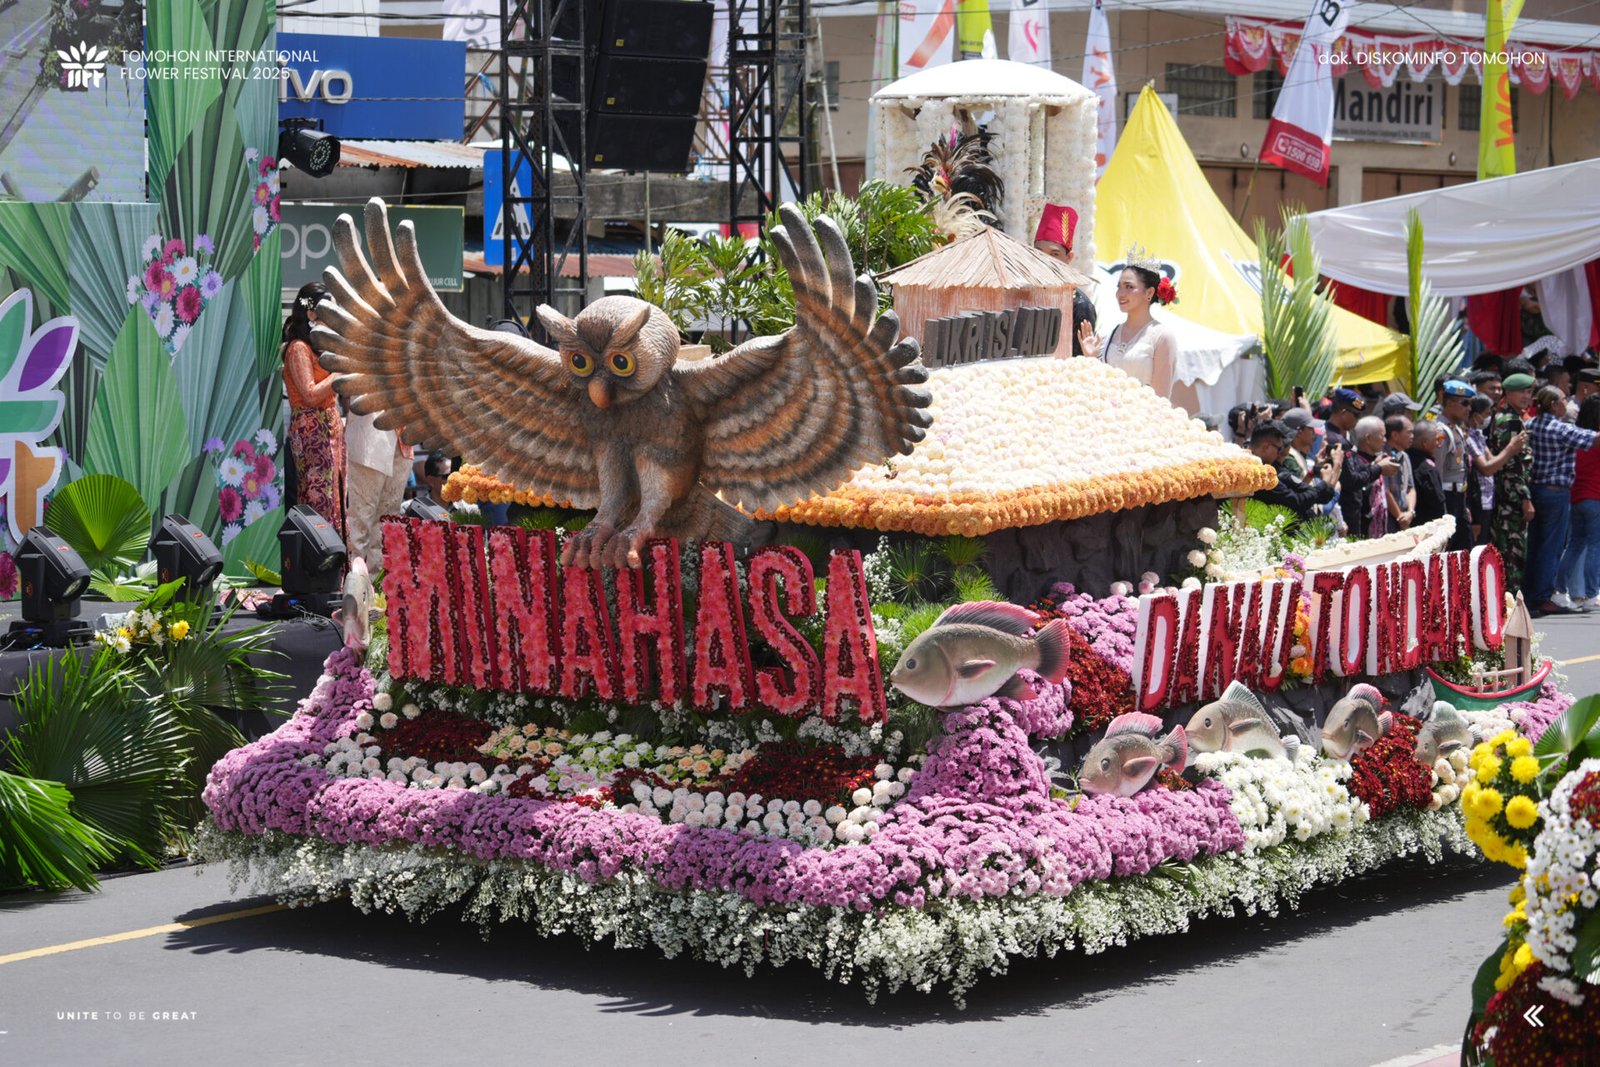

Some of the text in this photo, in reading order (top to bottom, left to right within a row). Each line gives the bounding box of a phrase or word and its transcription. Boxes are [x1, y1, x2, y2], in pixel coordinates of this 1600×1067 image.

[279, 54, 353, 105] ivo
[983, 306, 1062, 360] ISLAND
[380, 514, 887, 726] MINAHASA
[1132, 542, 1507, 713] DANAU TONDANO
